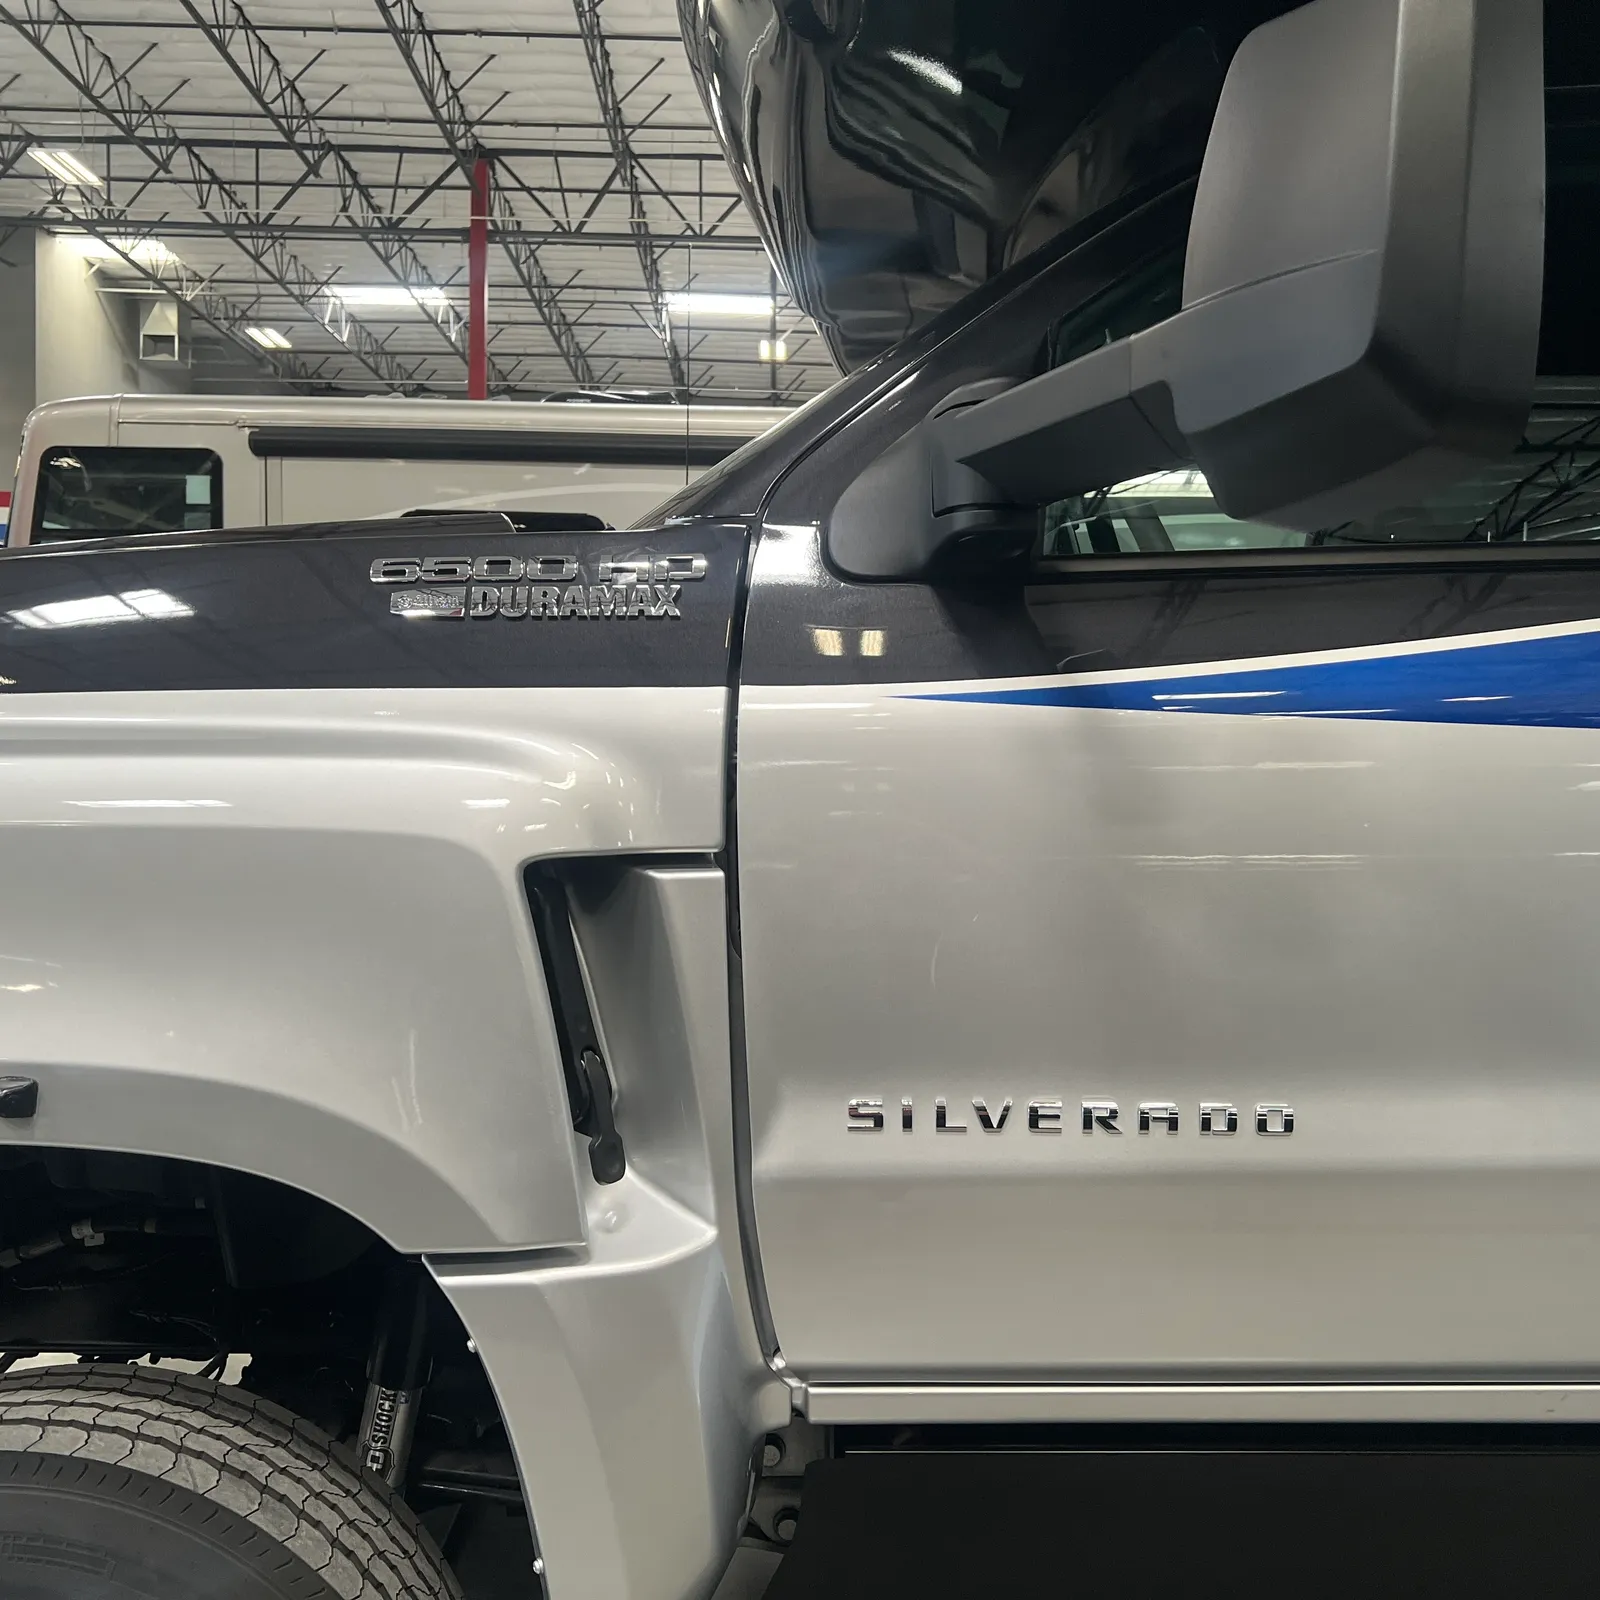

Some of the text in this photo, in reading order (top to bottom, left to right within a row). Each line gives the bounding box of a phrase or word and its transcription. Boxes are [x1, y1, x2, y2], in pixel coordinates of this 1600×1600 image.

[369, 553, 706, 582] 6500 HD
[469, 586, 681, 618] DURAMAX
[847, 1098, 1295, 1135] SILVERADO
[371, 1387, 398, 1446] SHOCK
